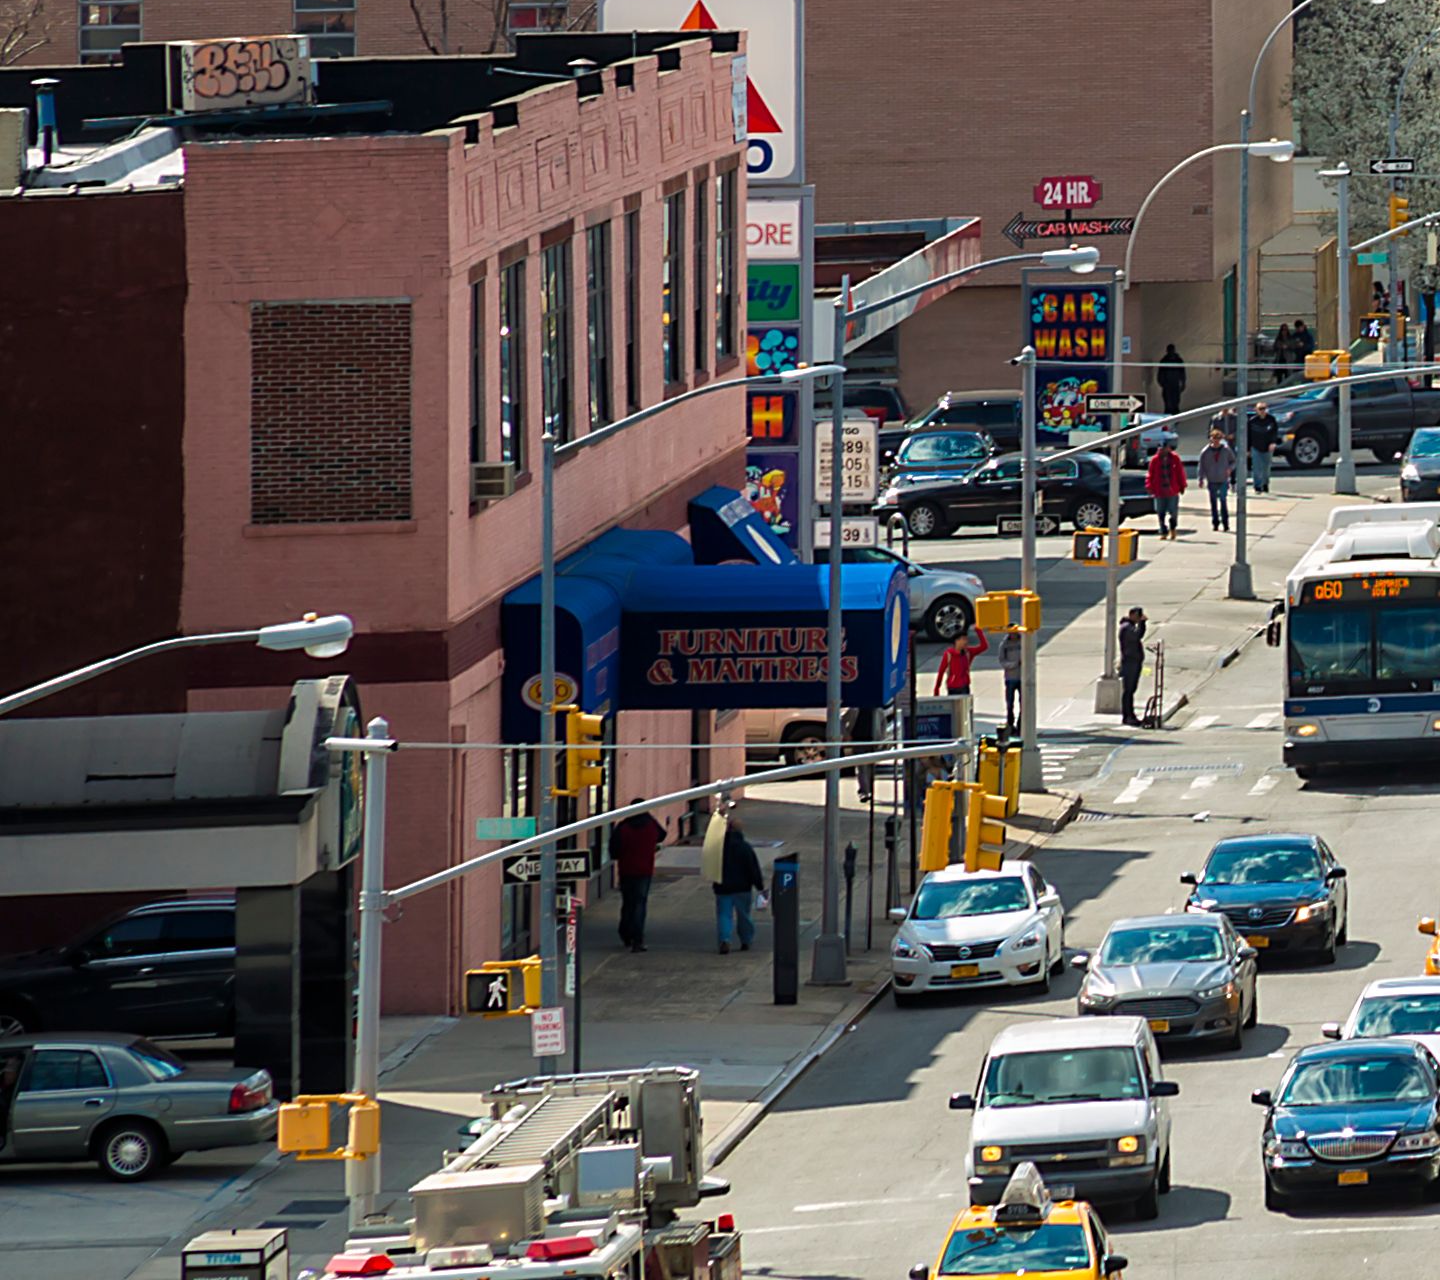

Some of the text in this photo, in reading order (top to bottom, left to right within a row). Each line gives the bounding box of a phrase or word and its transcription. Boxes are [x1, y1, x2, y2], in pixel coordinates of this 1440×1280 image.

[1043, 182, 1062, 205] 24
[1037, 221, 1109, 236] CAR WASH
[1043, 292, 1096, 323] CAR
[1035, 328, 1106, 358] WASH
[658, 627, 847, 657] FURNITUR
[647, 659, 678, 685] &
[515, 860, 541, 875] ONE
[783, 873, 793, 887] P
[206, 1253, 242, 1263] TITAN
